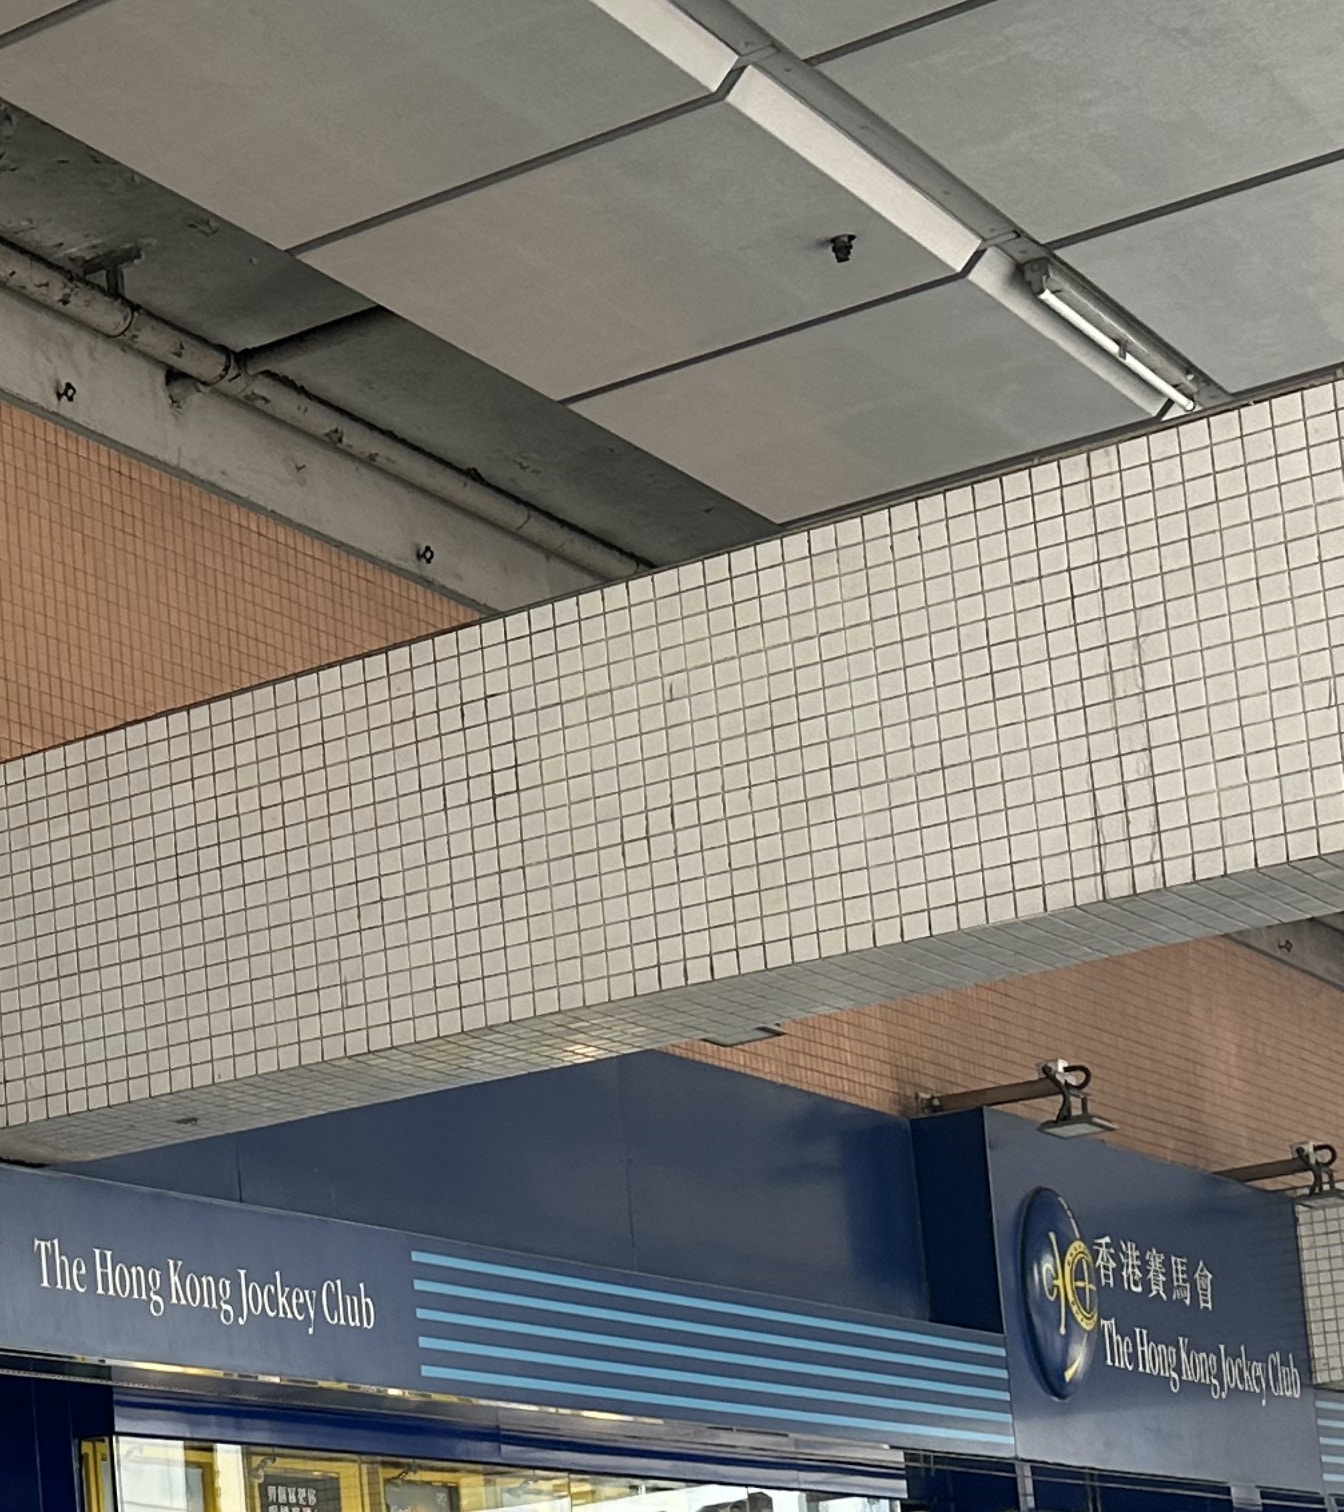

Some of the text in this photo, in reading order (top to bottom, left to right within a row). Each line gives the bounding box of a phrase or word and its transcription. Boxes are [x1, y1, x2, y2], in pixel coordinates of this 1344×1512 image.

[33, 1237, 377, 1336] The Hong Kong Jockey Club
[1092, 1235, 1214, 1311] 香港賽馬會
[1101, 1318, 1302, 1407] The Hong Kong Jockey Club
